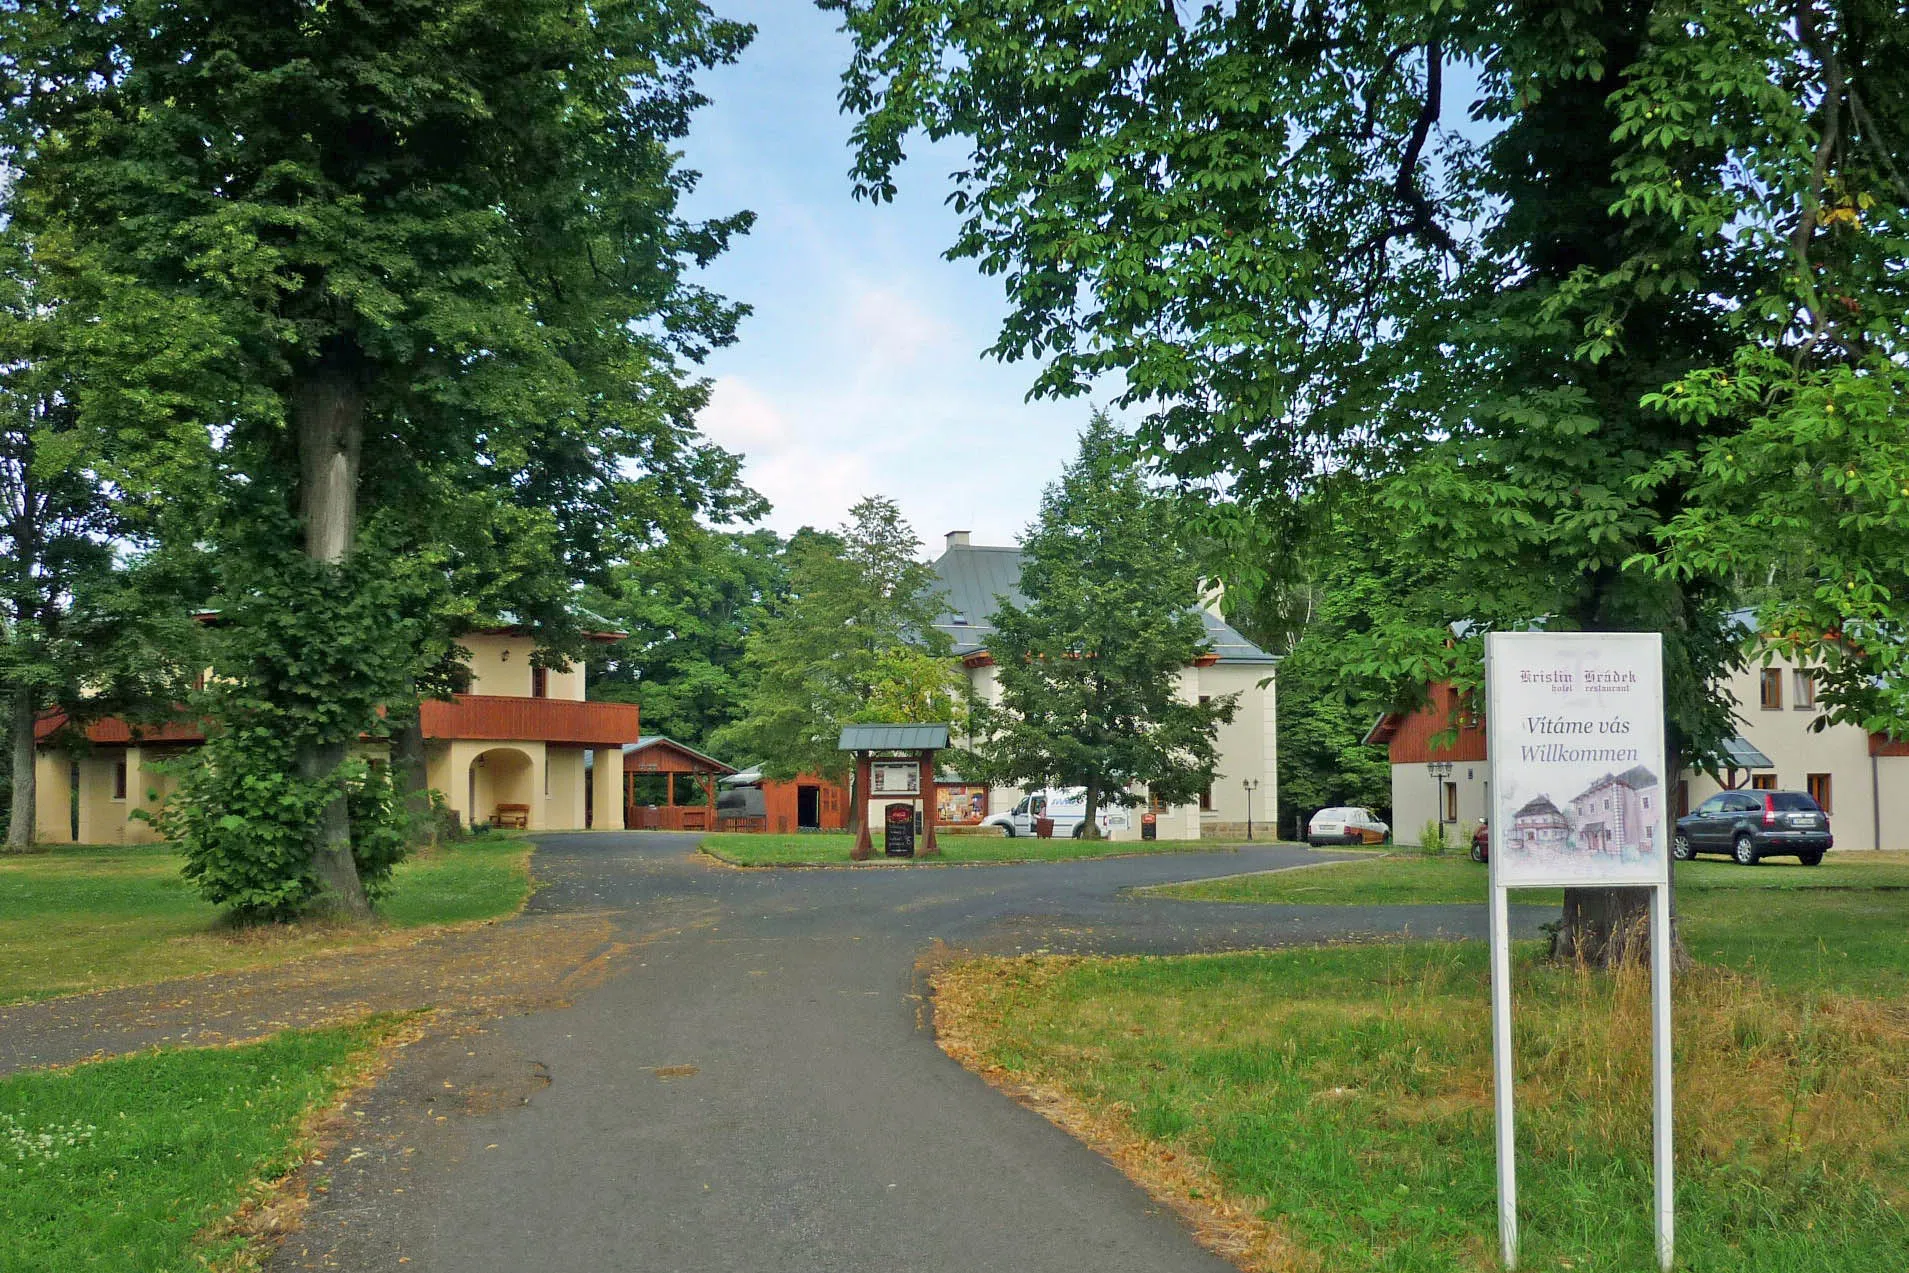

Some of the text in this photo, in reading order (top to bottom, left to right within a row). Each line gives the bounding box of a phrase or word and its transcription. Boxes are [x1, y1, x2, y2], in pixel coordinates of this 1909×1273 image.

[1520, 669, 1573, 683] Kristin
[1526, 716, 1630, 734] Vítáme vás
[1521, 743, 1638, 762] Willkommen
